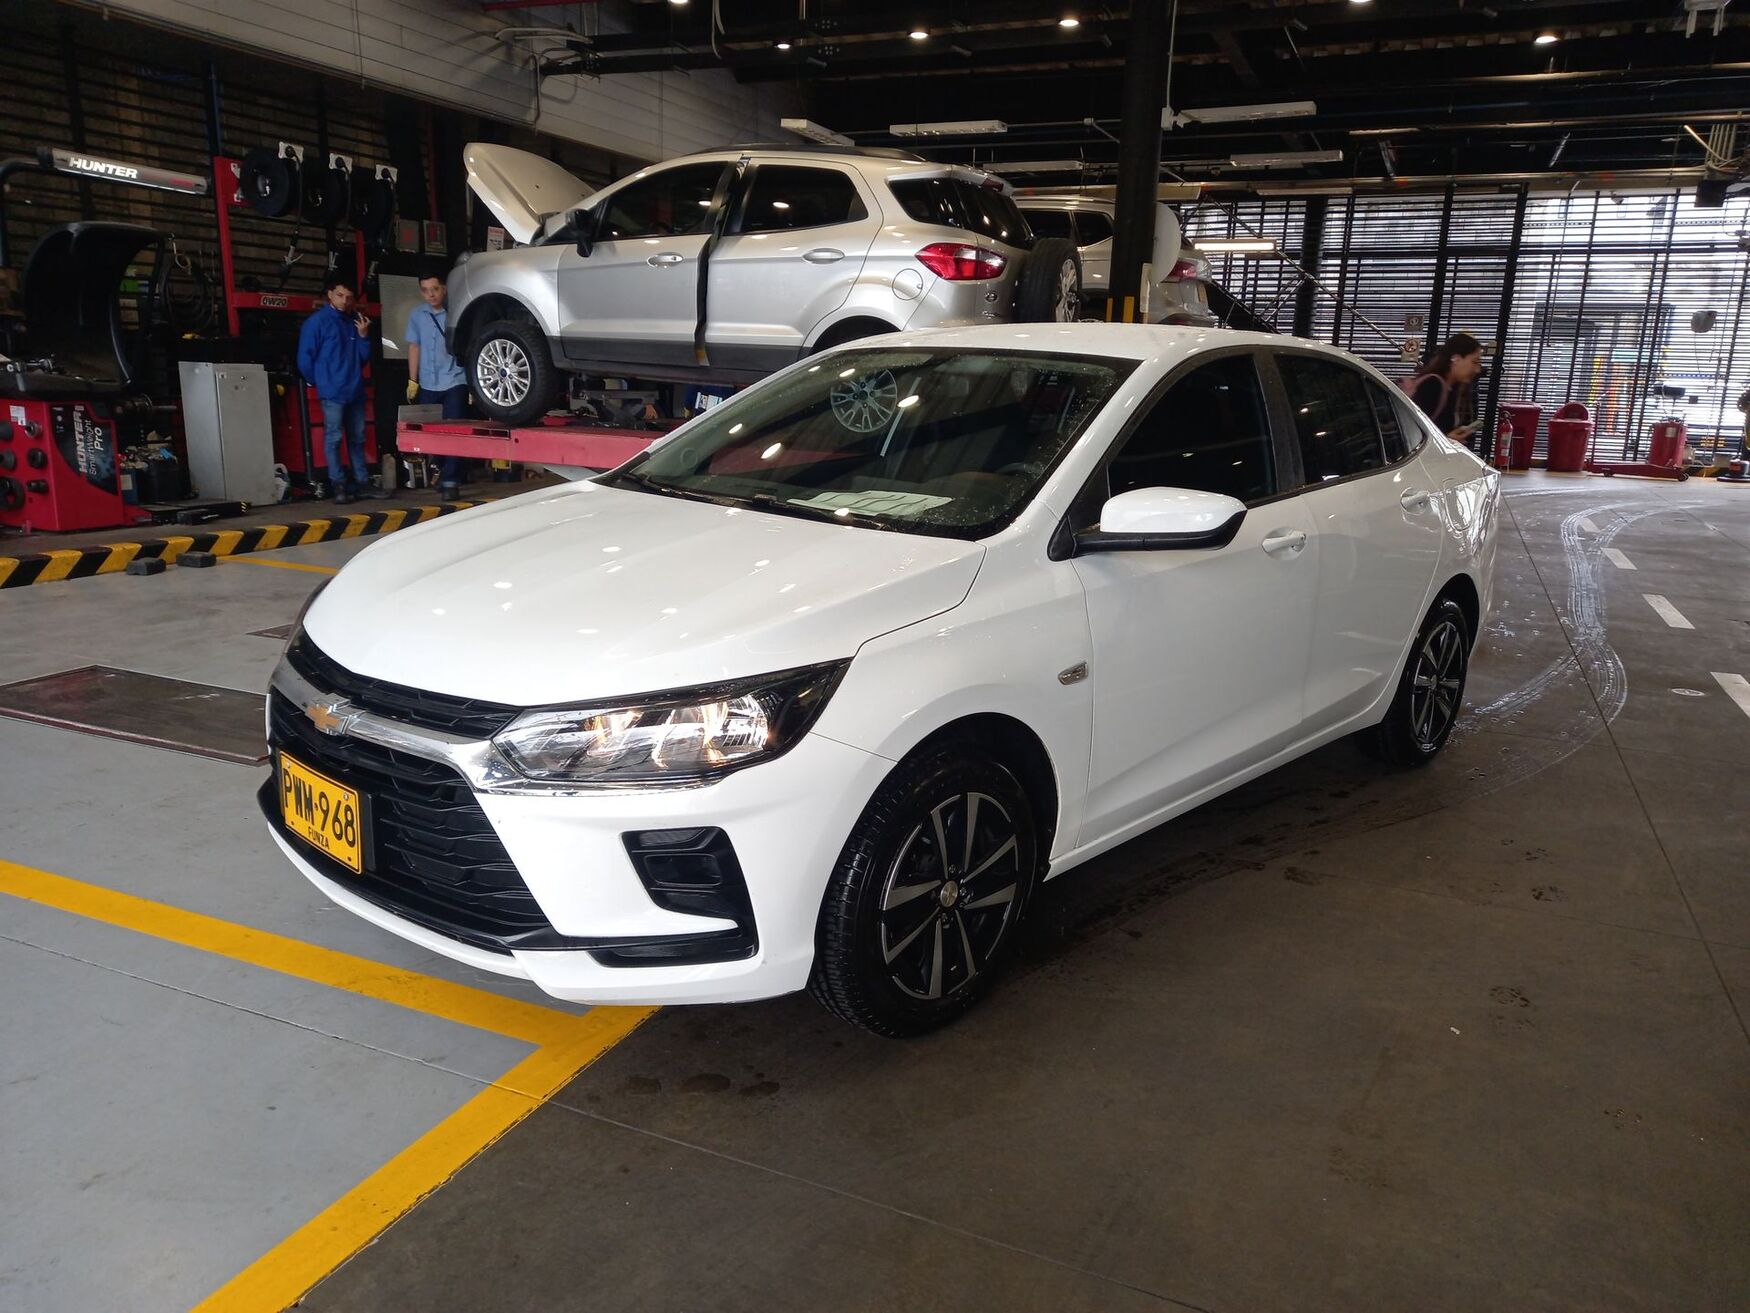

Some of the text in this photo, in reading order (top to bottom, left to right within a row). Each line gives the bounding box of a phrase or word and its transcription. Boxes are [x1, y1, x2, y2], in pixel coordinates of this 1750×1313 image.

[69, 157, 138, 179] HUNTER
[74, 411, 87, 473] HUNTER
[94, 427, 104, 451] Pro
[308, 826, 330, 850] FUNZA
